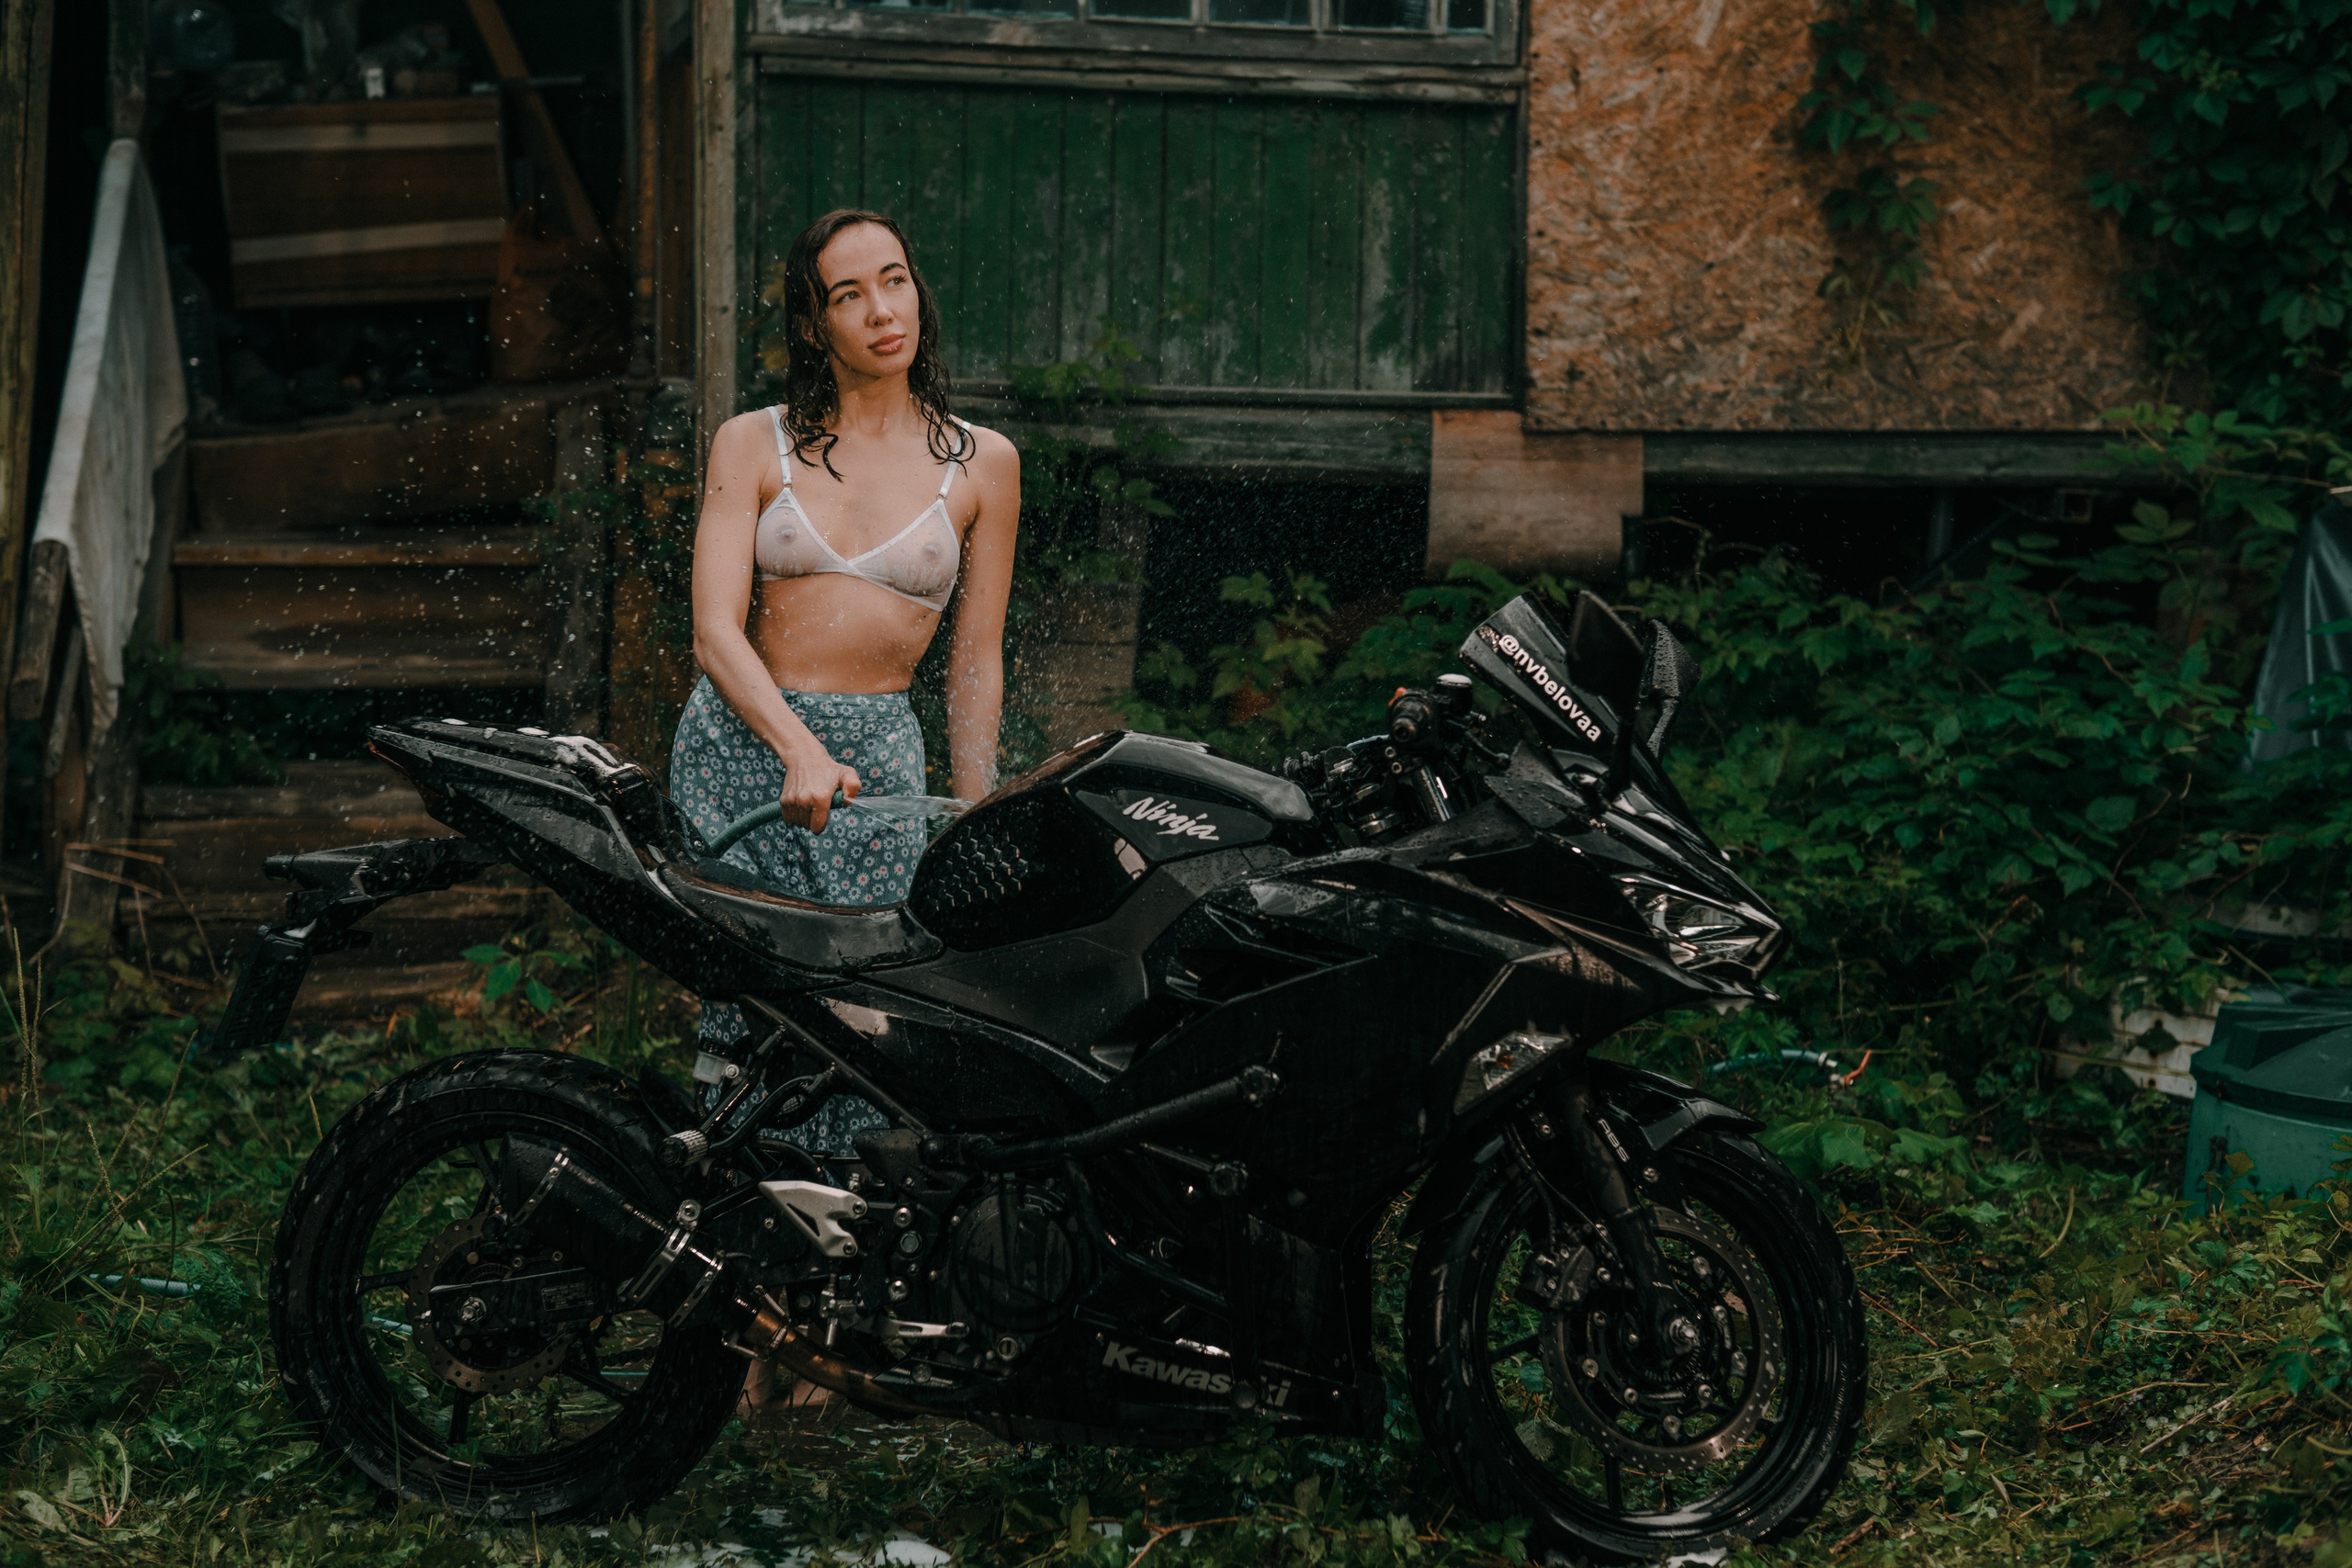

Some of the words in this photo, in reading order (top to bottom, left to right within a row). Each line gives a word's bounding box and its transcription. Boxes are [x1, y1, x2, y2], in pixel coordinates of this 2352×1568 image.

[1498, 634, 1602, 742] @nvbelovaa
[1123, 796, 1219, 840] Ninja
[1597, 1118, 1631, 1162] ABS
[1102, 1340, 1292, 1408] Kawaski
